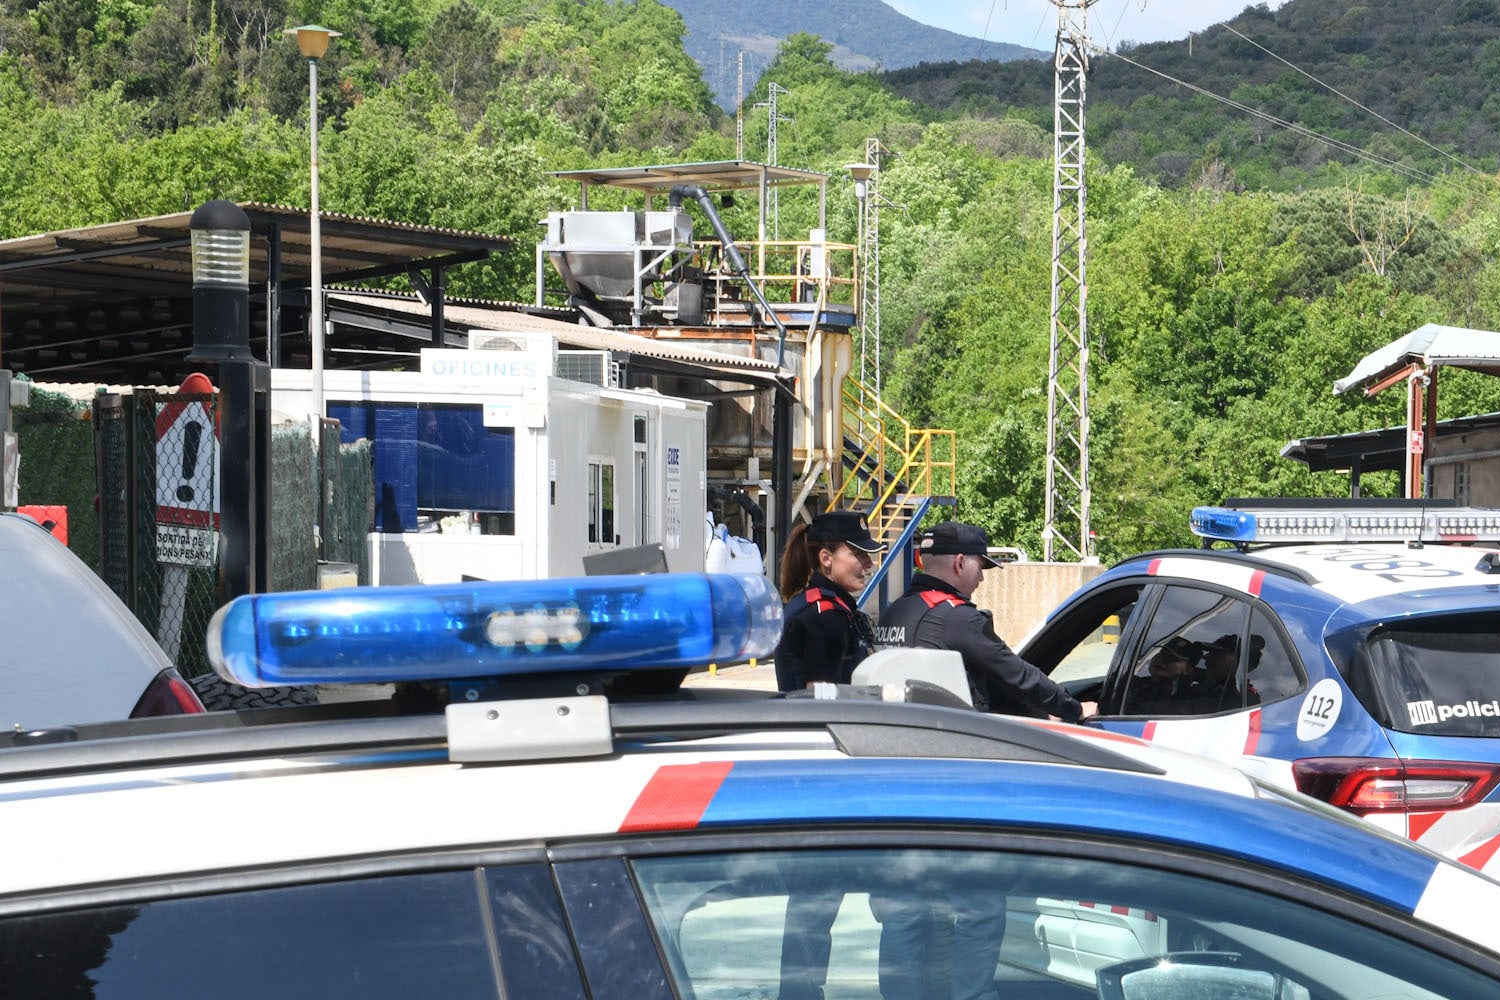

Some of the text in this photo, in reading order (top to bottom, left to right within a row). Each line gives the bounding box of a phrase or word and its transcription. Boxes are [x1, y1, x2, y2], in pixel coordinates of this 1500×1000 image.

[431, 359, 537, 377] OFICINES
[157, 532, 191, 546] SORTIDA
[1307, 695, 1335, 719] 112
